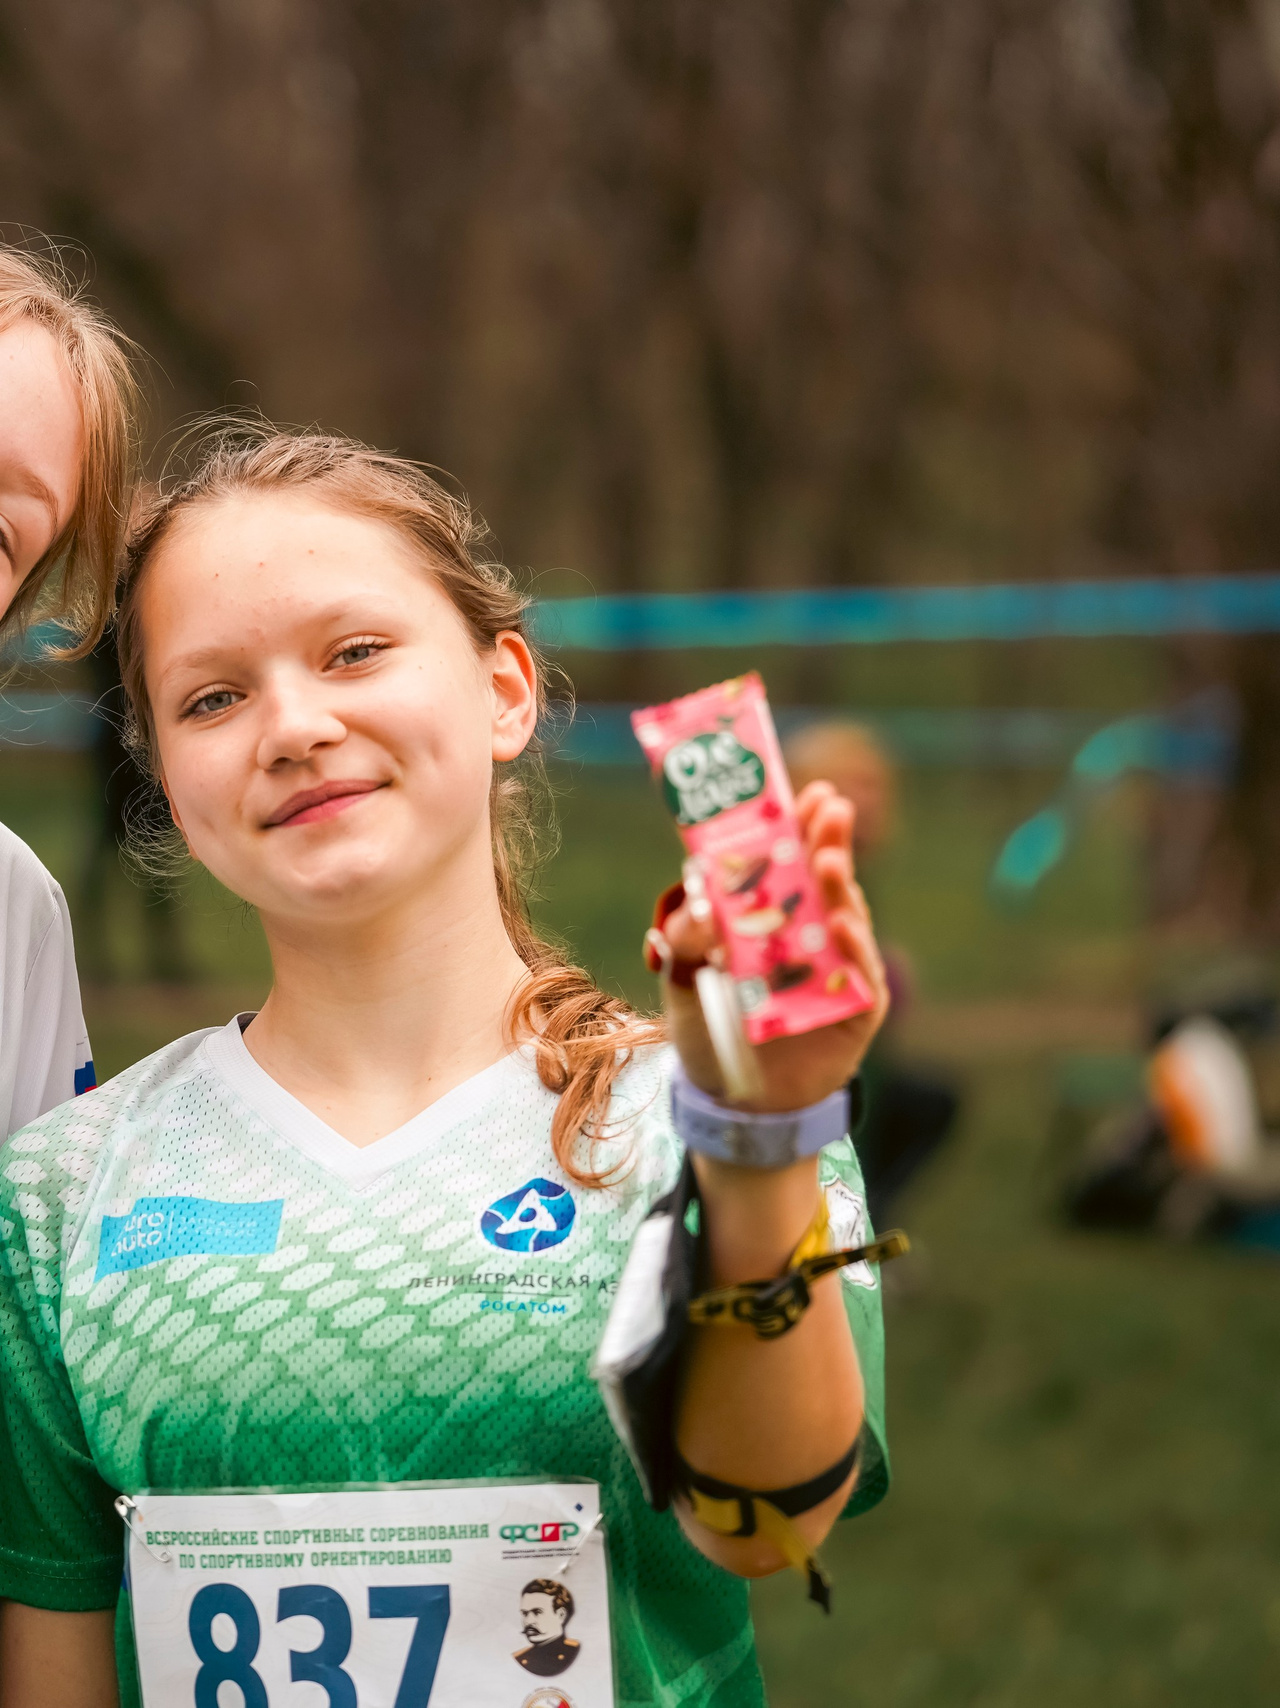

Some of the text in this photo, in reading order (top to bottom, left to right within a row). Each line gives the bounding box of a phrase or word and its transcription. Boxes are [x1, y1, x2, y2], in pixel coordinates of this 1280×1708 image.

[408, 1272, 590, 1289] ЛЕНИНГРАДСКАЯ
[480, 1300, 566, 1315] РОСАТОМ
[146, 1524, 490, 1546] ВСЕРОССИЙСКИЕ СПОРТИВНЫЕ СОРЕВНОВАНИЯ
[179, 1548, 453, 1569] ПО СПОРТИВНОМУ ОРИЕНТИРОВАНИЮ
[188, 1582, 452, 1708] 837
